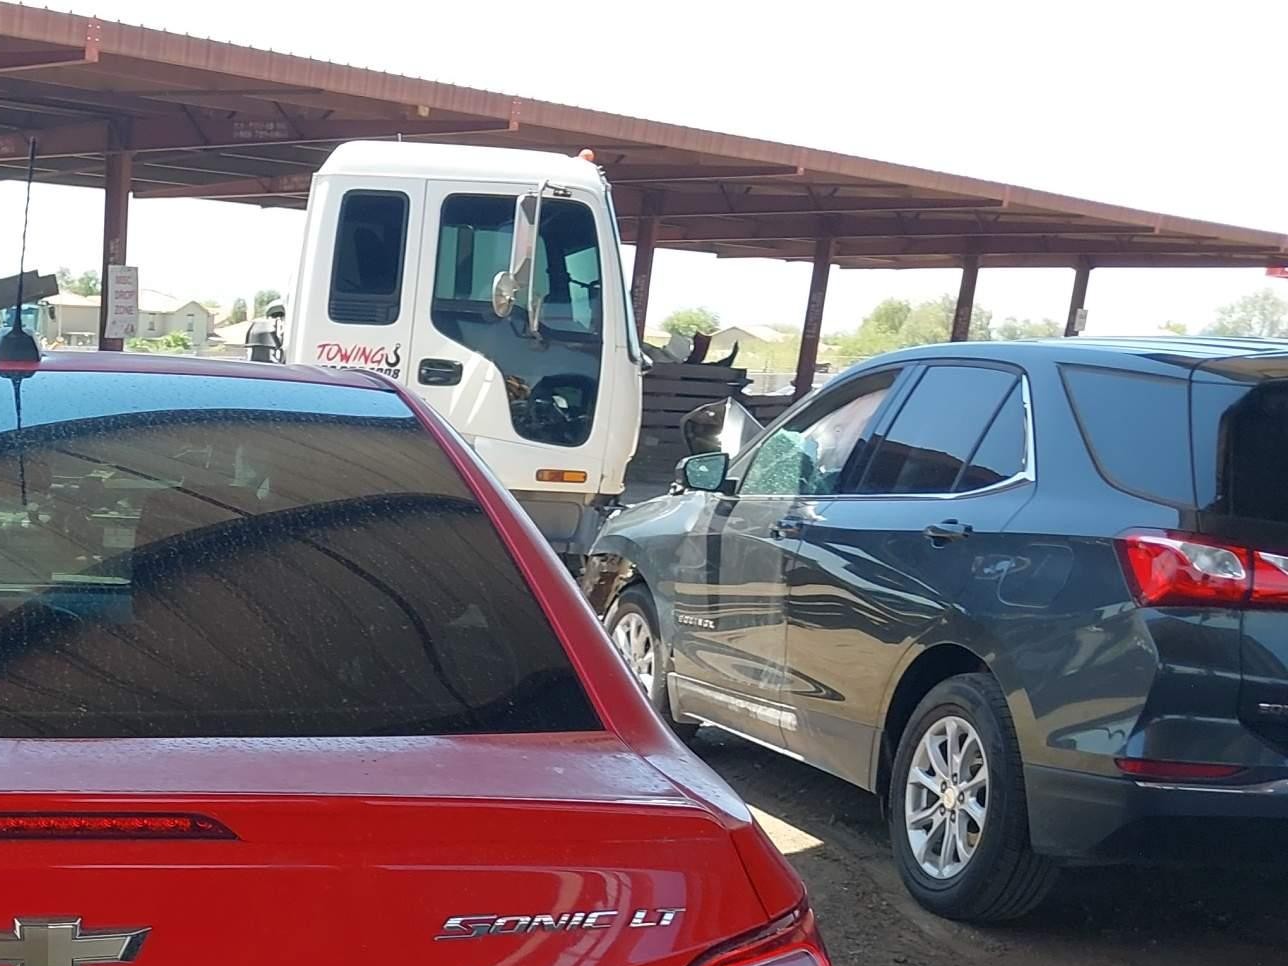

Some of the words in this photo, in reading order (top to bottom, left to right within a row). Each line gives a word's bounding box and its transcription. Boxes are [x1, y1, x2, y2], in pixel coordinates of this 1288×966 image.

[317, 343, 385, 365] TOWING
[434, 909, 618, 941] SONIC
[629, 908, 686, 928] LT
